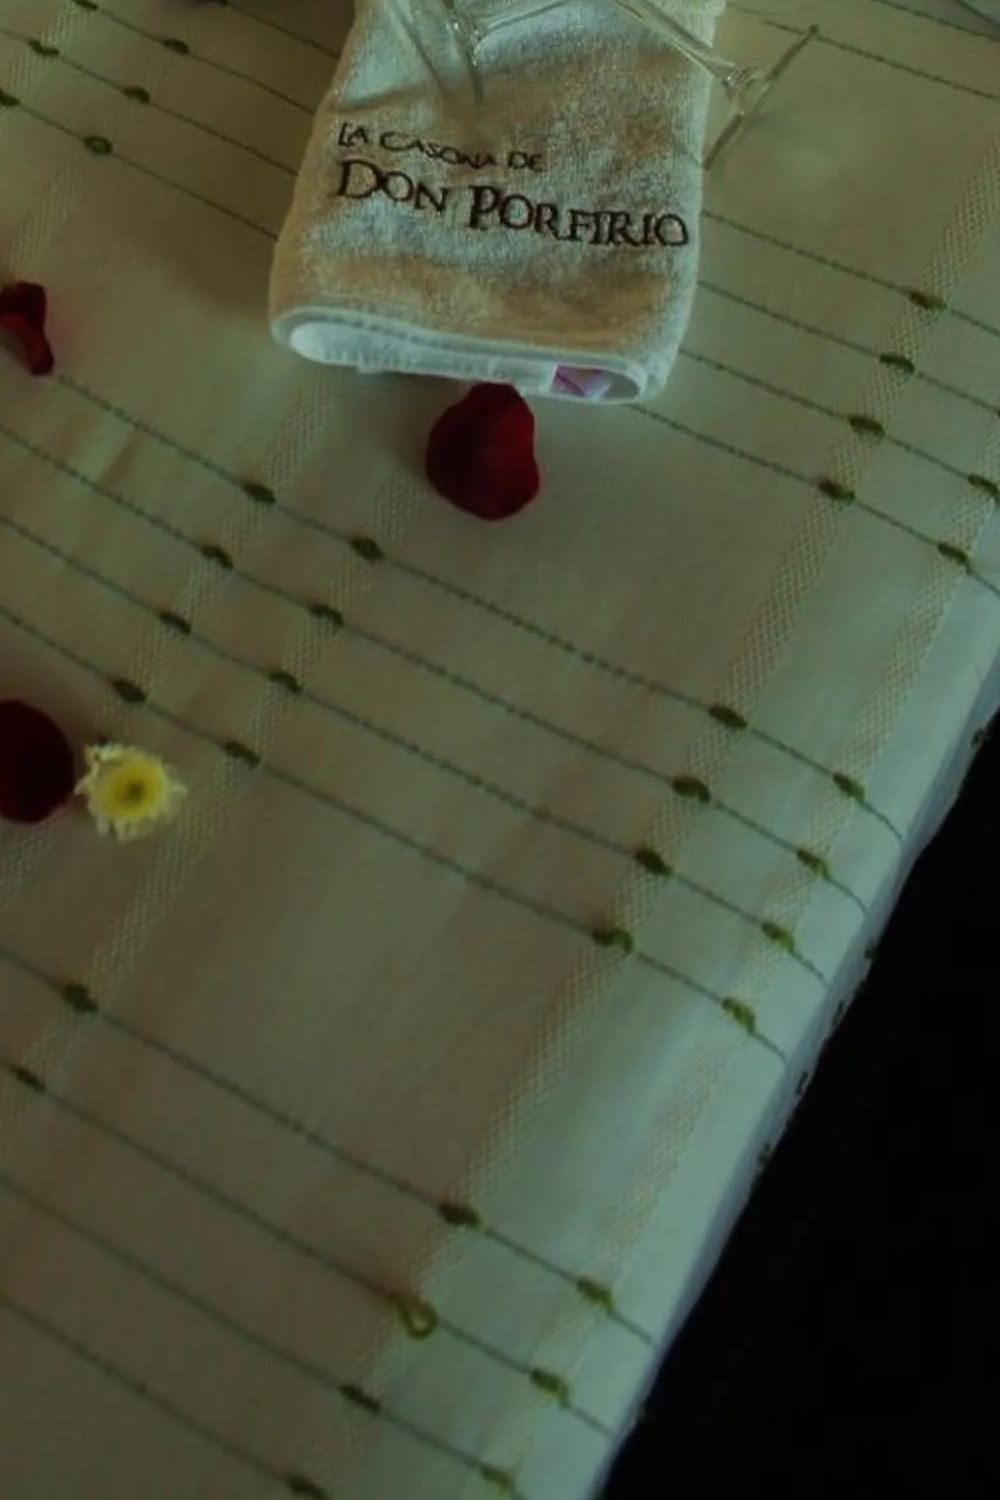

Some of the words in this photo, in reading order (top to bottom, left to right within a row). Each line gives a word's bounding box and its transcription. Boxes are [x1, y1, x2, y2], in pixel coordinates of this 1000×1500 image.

[338, 121, 369, 148] LA
[379, 130, 497, 170] CASONA
[507, 150, 545, 172] DE
[338, 158, 447, 214] DON
[468, 184, 690, 248] PORFIRIO
